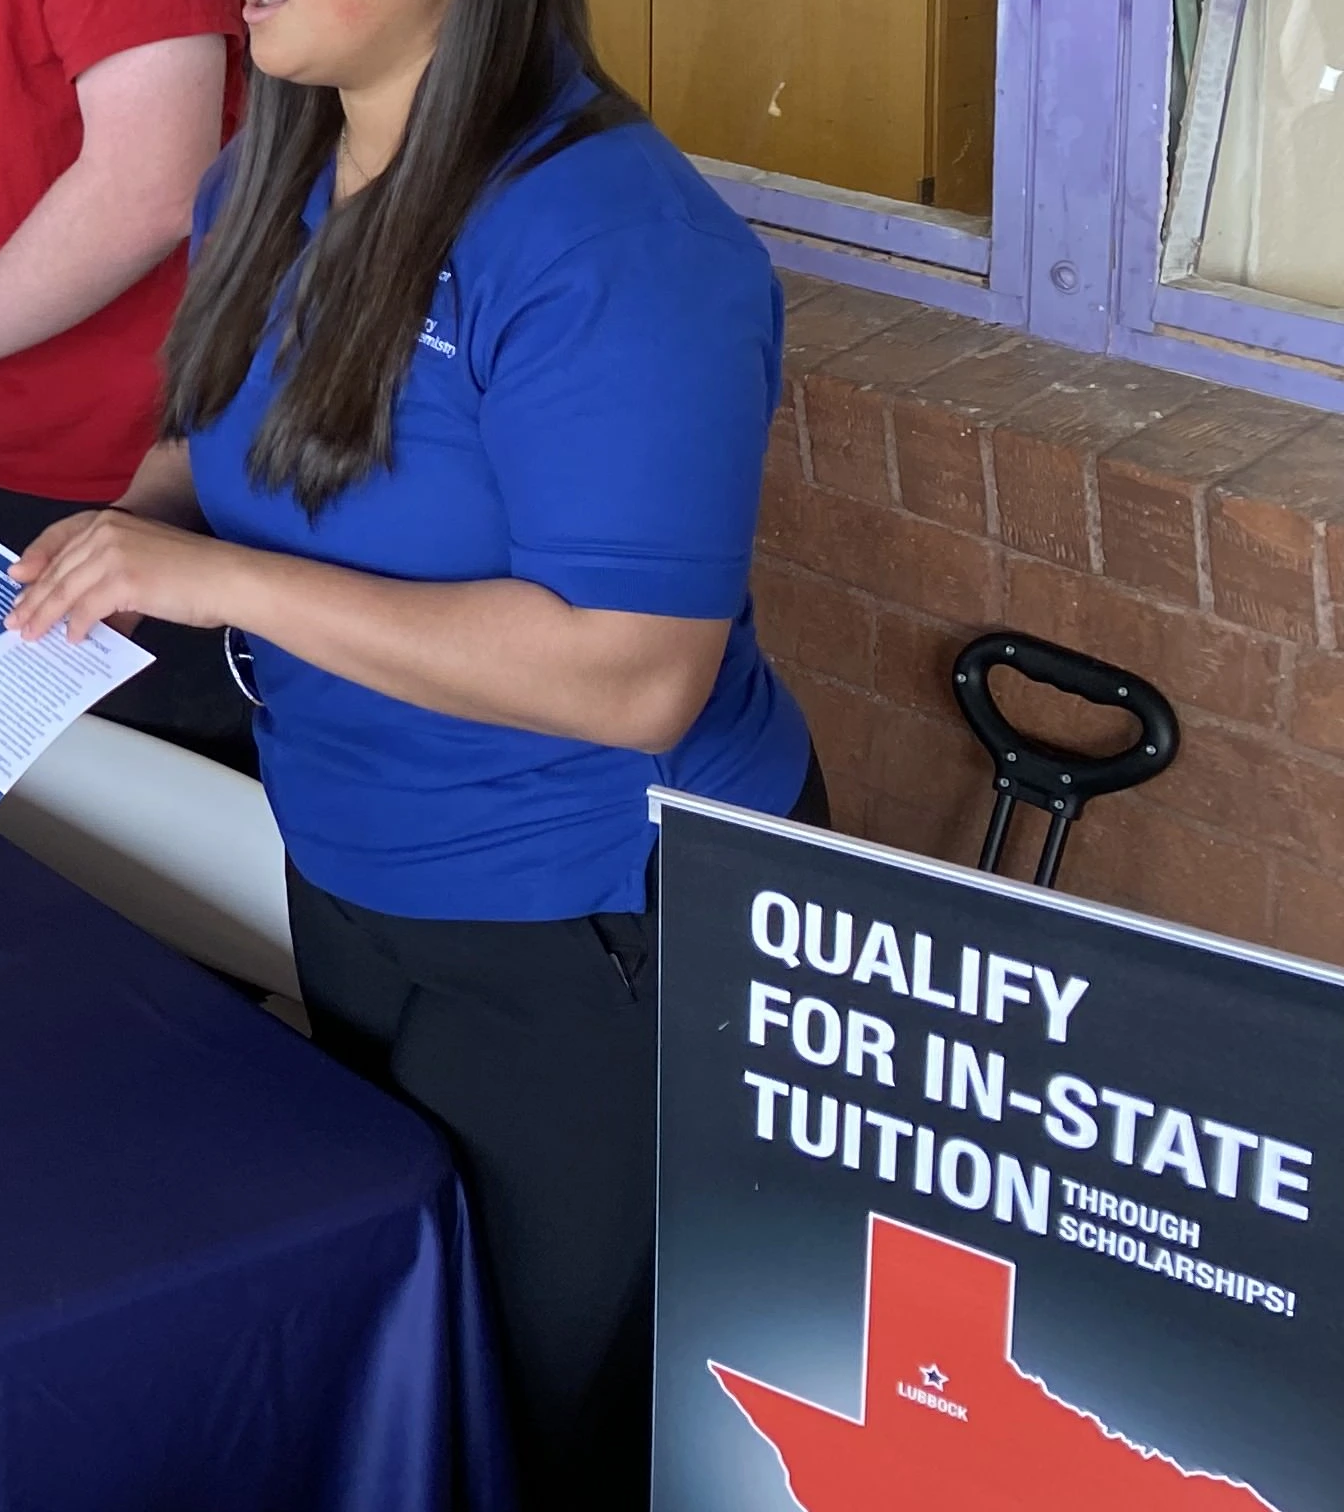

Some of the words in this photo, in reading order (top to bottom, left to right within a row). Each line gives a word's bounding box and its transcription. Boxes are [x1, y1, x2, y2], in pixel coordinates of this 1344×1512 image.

[751, 890, 1090, 1043] QUALIFY
[744, 1070, 1051, 1236] TUITION
[748, 980, 896, 1087] FOR
[924, 1034, 1313, 1222] IN-STATE
[1059, 1214, 1297, 1318] SCHOLARSHIPS!
[1061, 1177, 1201, 1249] THROUGH
[897, 1381, 969, 1423] LUBBOCK
